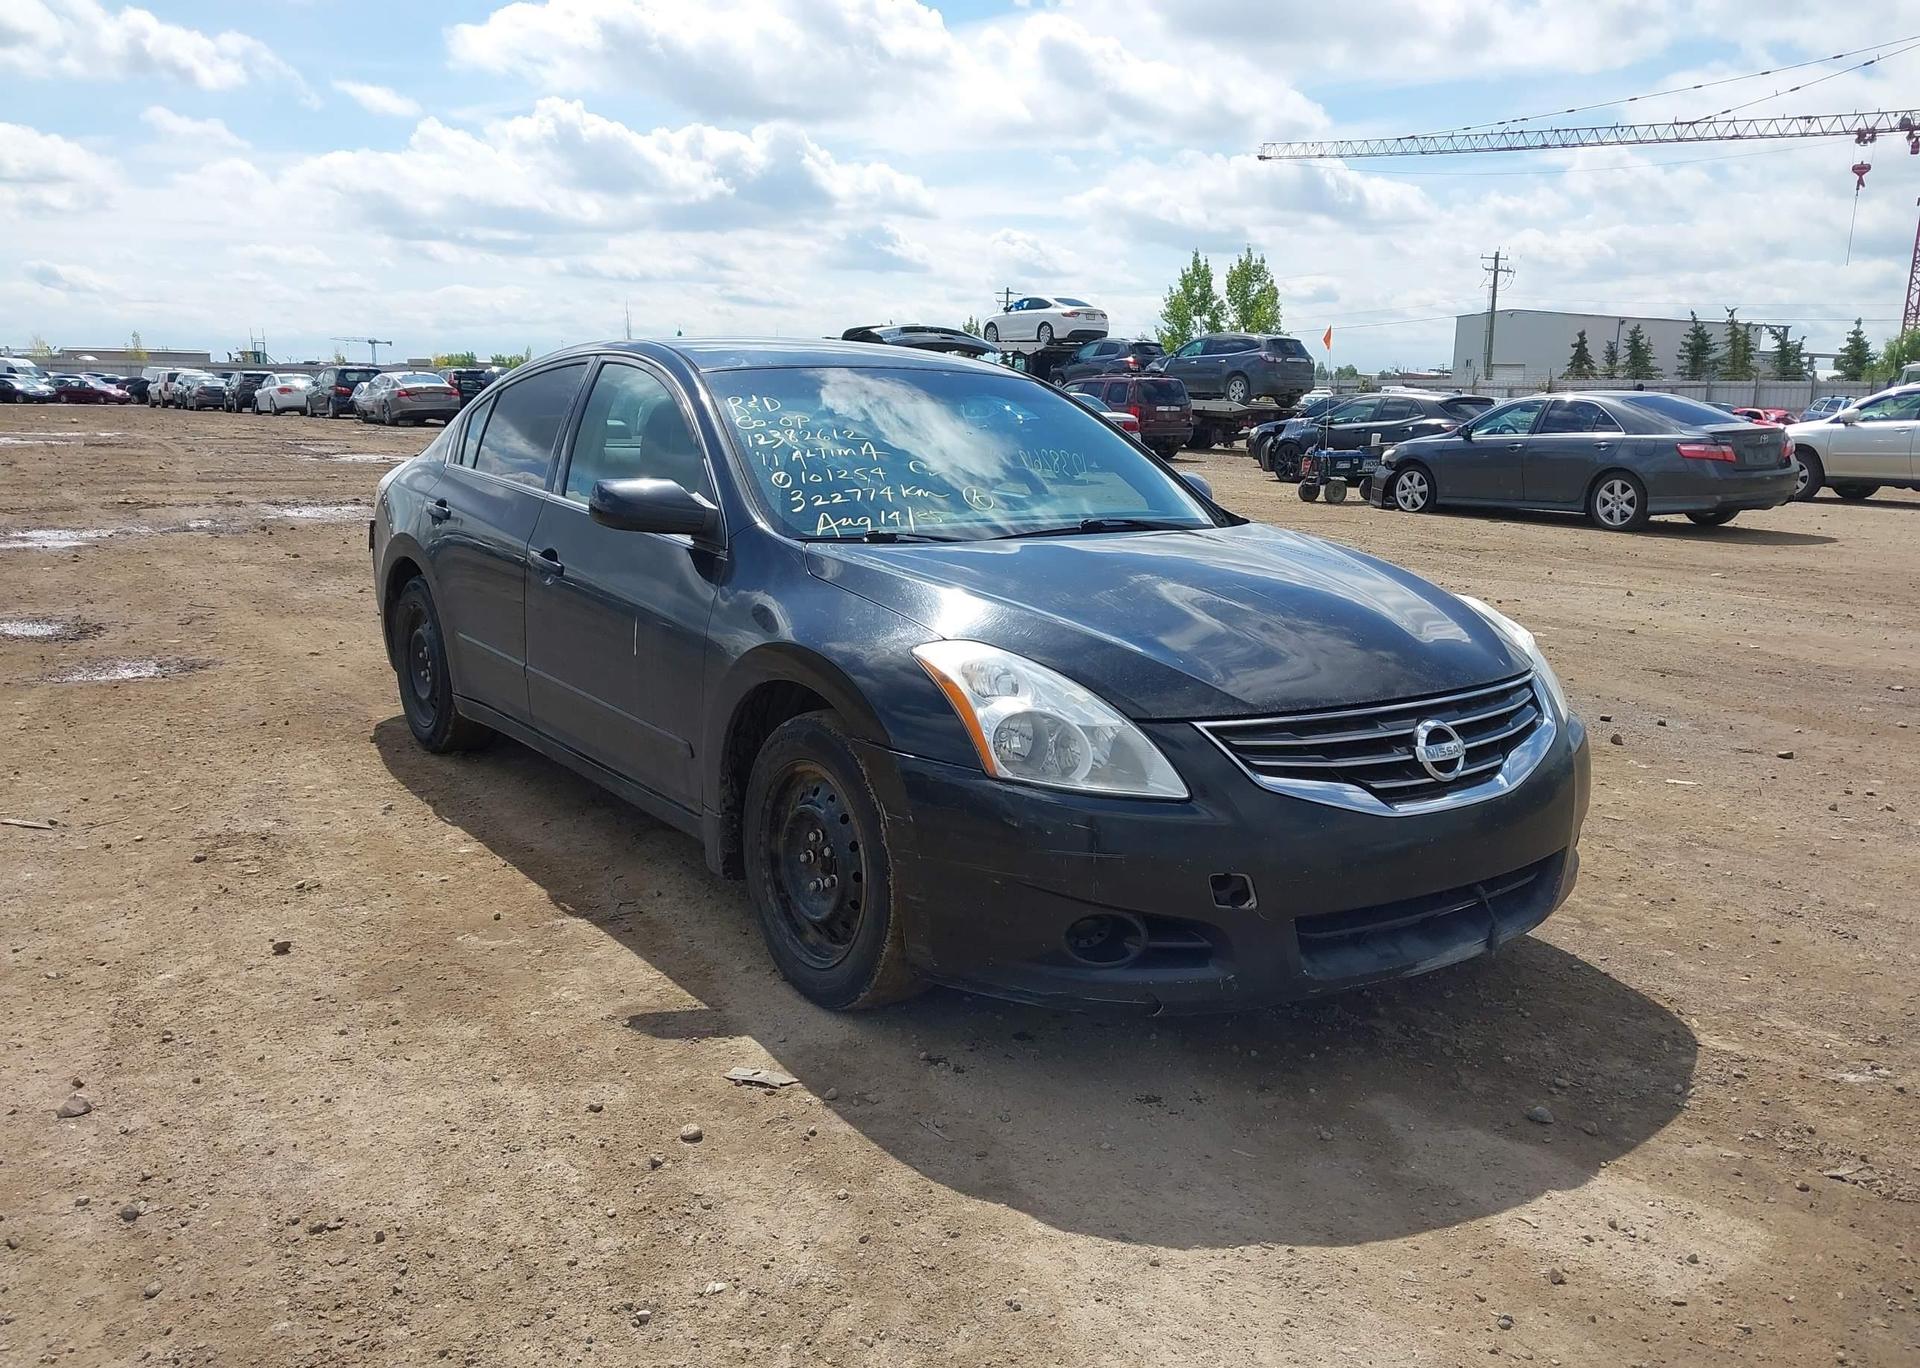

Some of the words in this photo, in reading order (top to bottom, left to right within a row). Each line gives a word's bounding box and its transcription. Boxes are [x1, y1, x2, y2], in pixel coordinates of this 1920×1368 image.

[728, 395, 781, 416] R&D
[747, 429, 869, 449] 12382612
[801, 467, 887, 484] 101254
[790, 486, 894, 513] 322774
[817, 512, 872, 539] Aug
